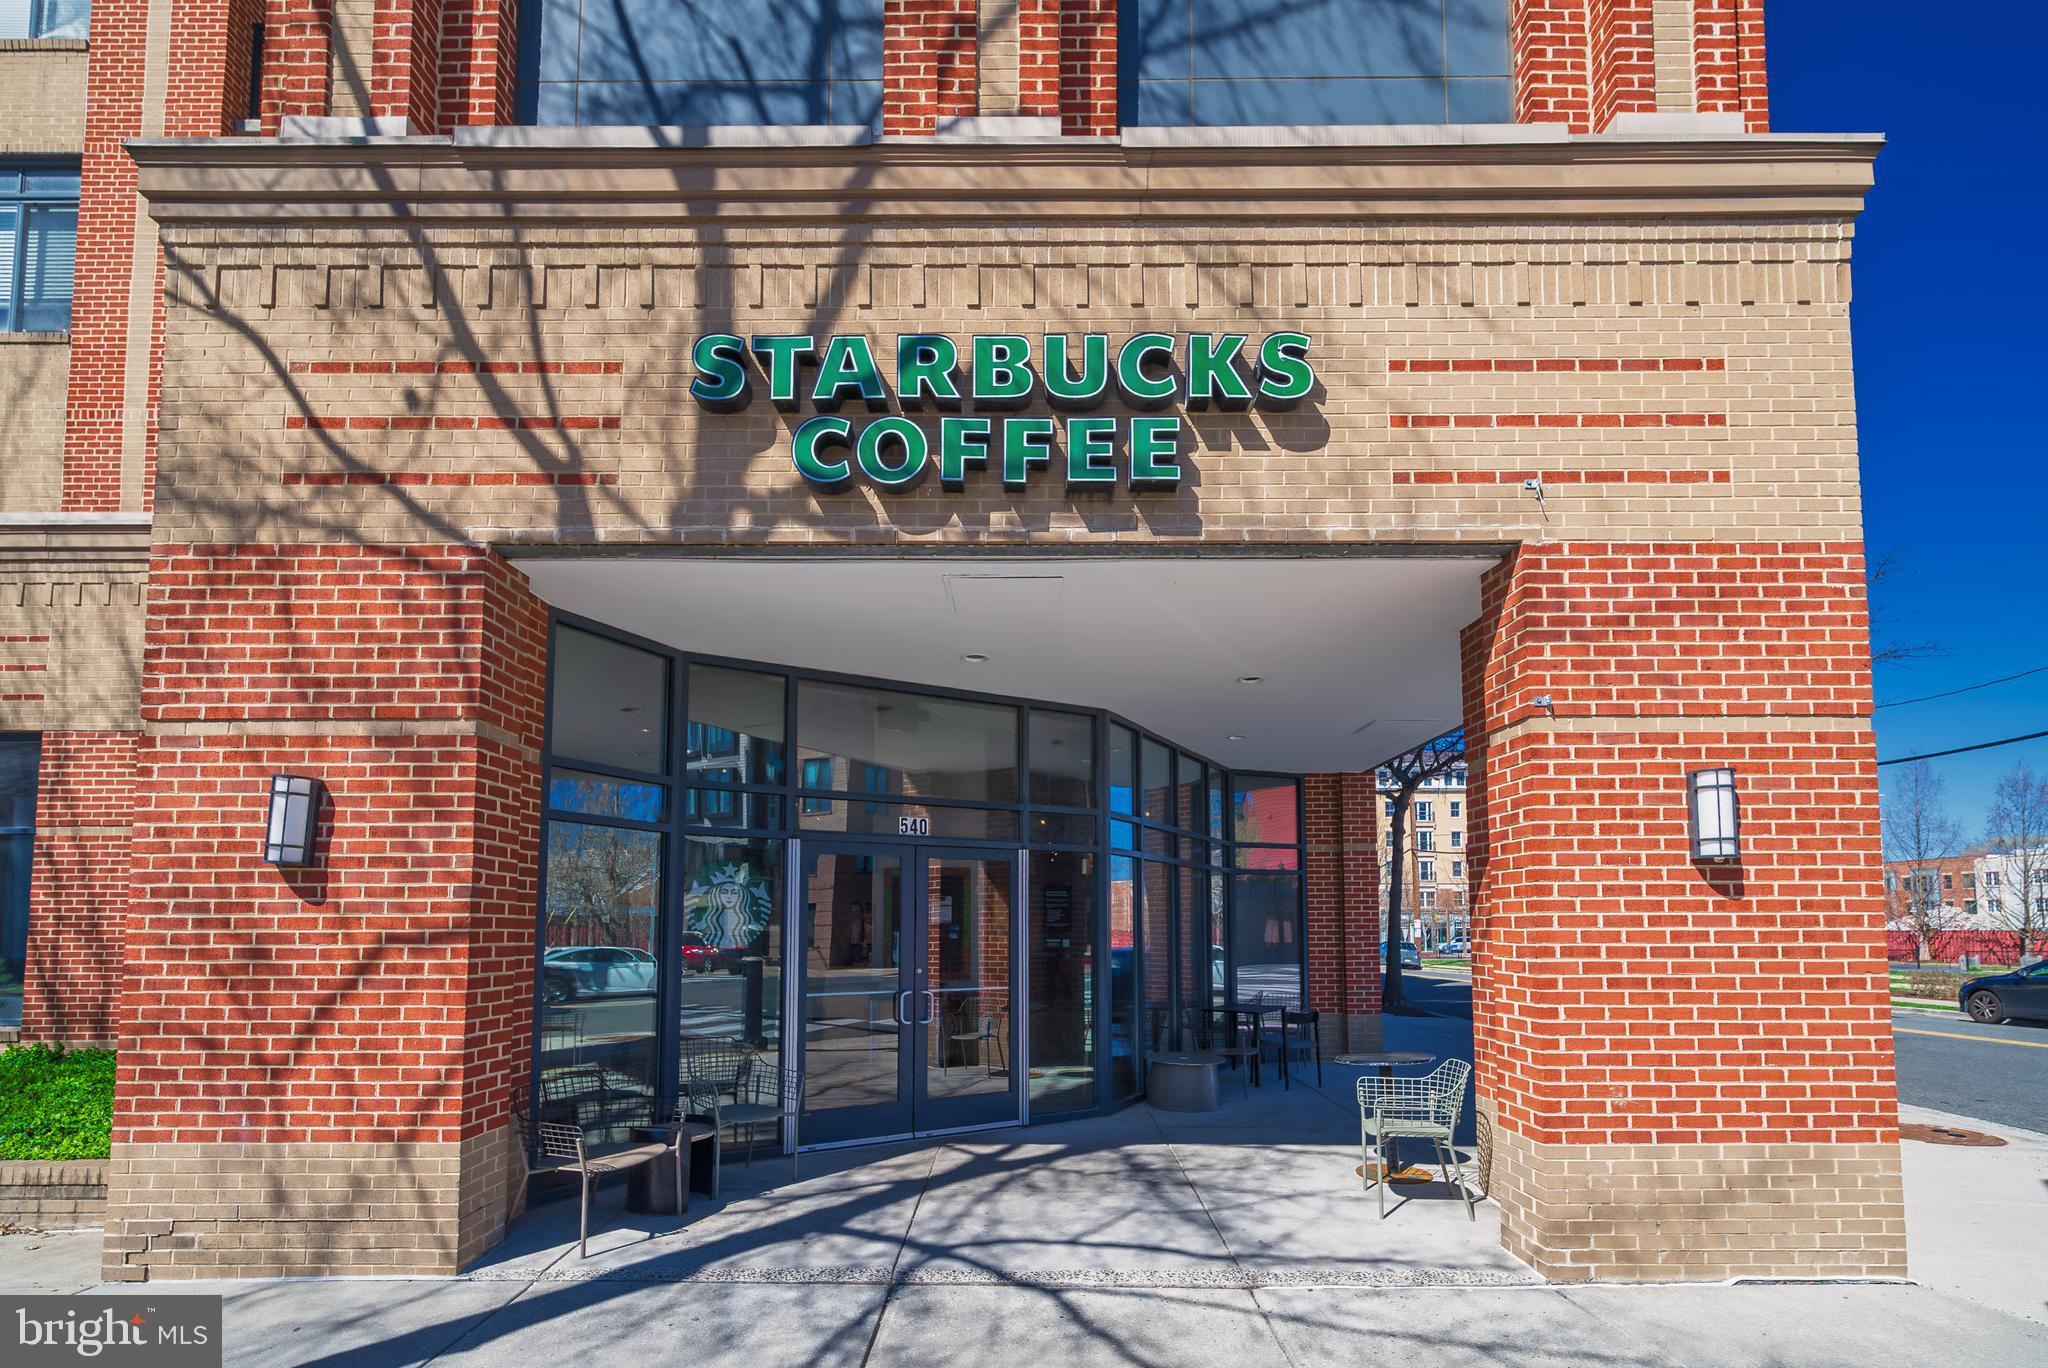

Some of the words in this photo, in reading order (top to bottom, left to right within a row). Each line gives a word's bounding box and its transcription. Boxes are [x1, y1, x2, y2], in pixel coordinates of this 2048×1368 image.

[690, 333, 1315, 407] STARBUCKS
[792, 415, 1182, 487] COFFEE
[900, 818, 928, 835] 540
